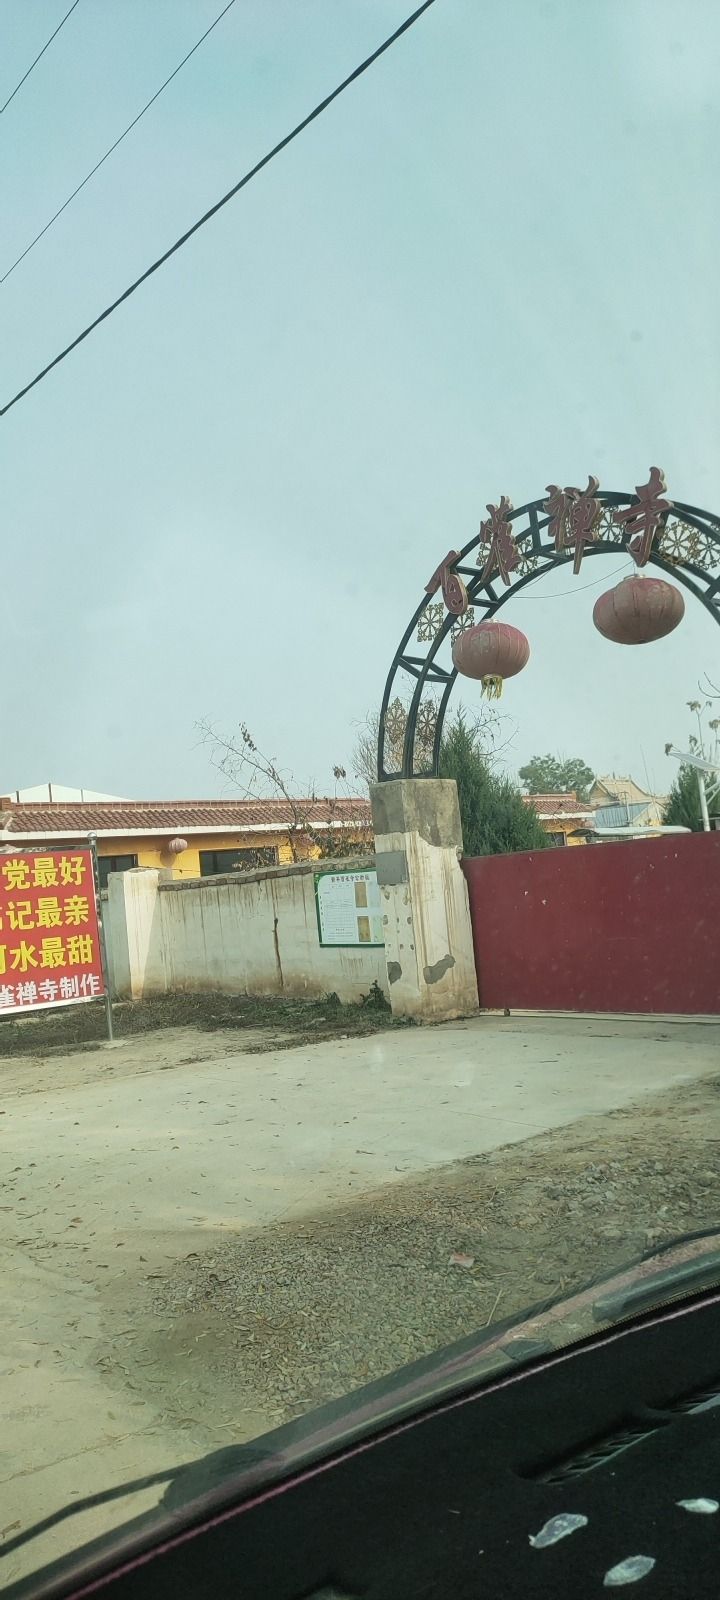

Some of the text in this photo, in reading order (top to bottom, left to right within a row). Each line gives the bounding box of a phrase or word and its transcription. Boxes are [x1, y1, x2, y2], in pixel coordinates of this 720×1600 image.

[2, 856, 86, 891] 党最好
[0, 894, 89, 930] 记最亲
[0, 934, 93, 975] 水最甜
[0, 973, 100, 1009] 雀禅寺制作
